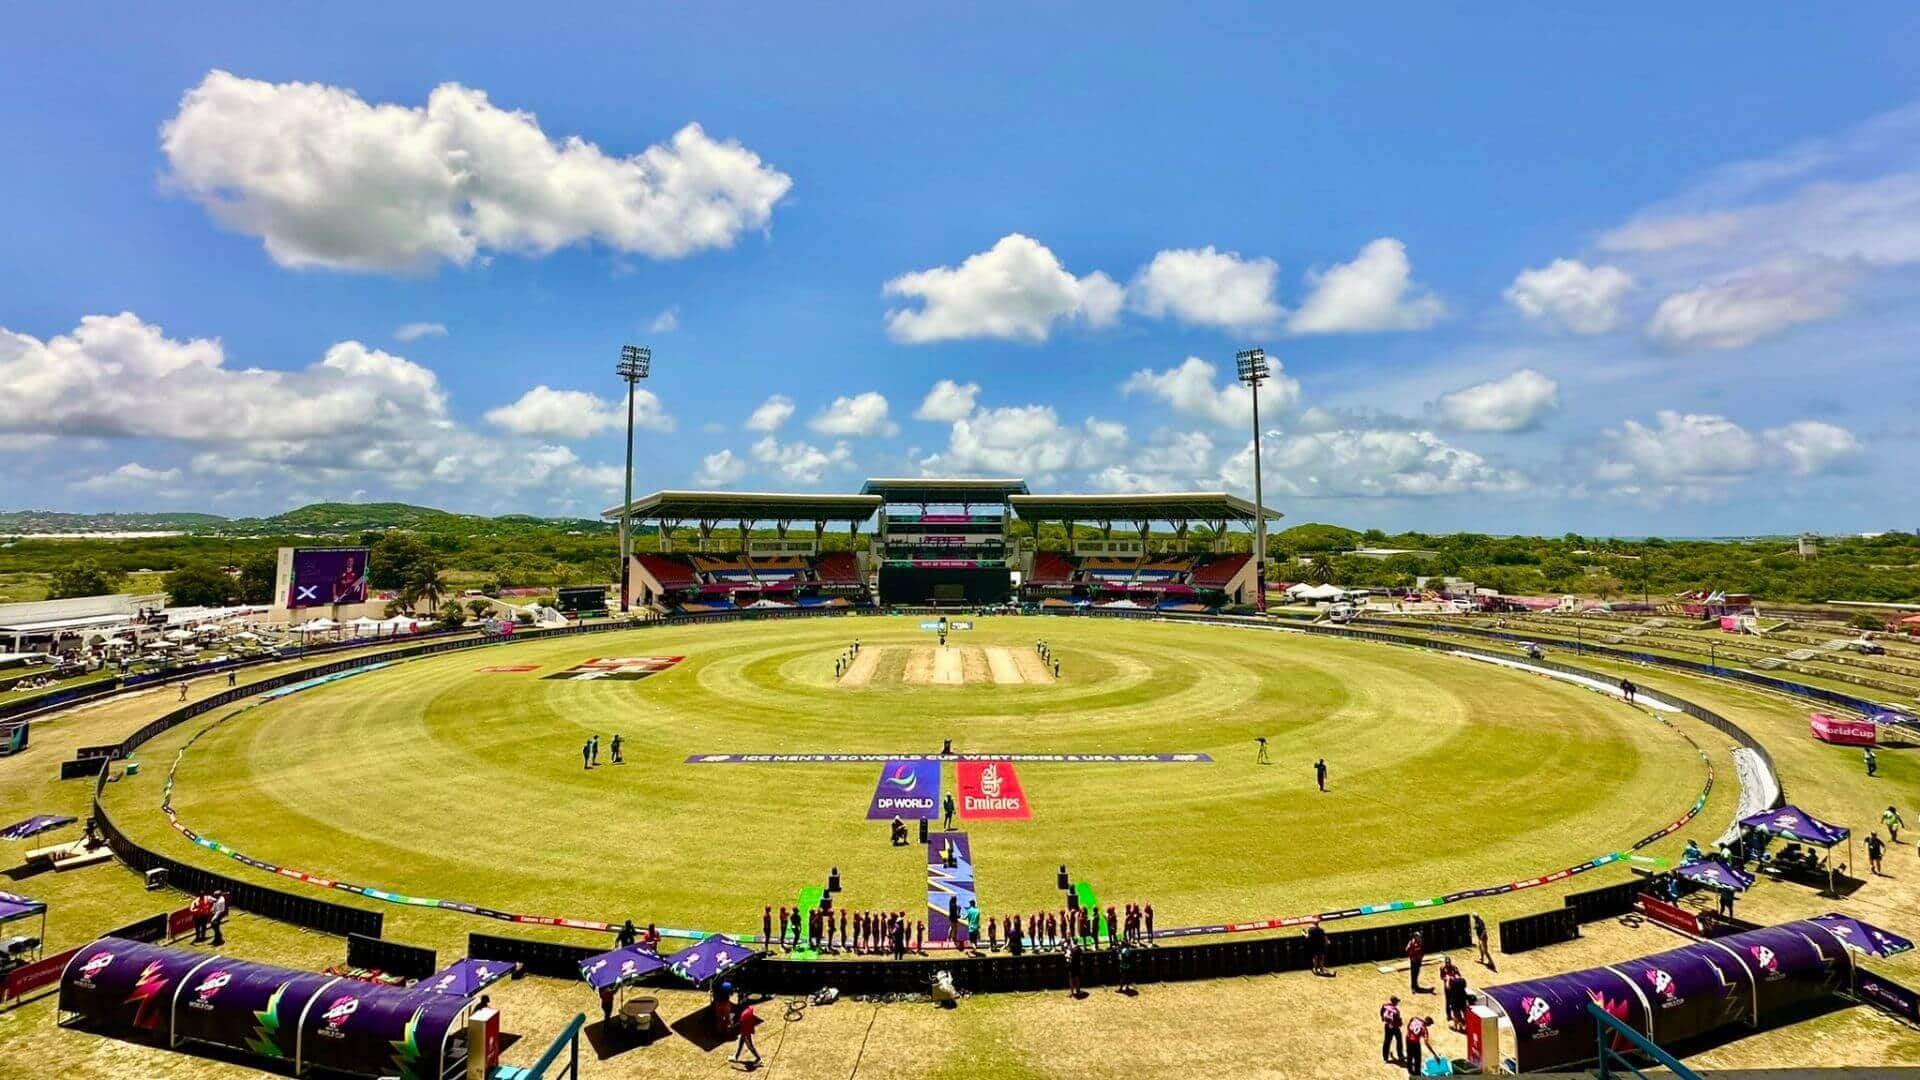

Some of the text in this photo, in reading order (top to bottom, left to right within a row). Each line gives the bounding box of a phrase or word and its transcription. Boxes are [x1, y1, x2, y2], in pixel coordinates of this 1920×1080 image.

[878, 798, 933, 809] DP WORLD
[964, 795, 1020, 811] Emirates
